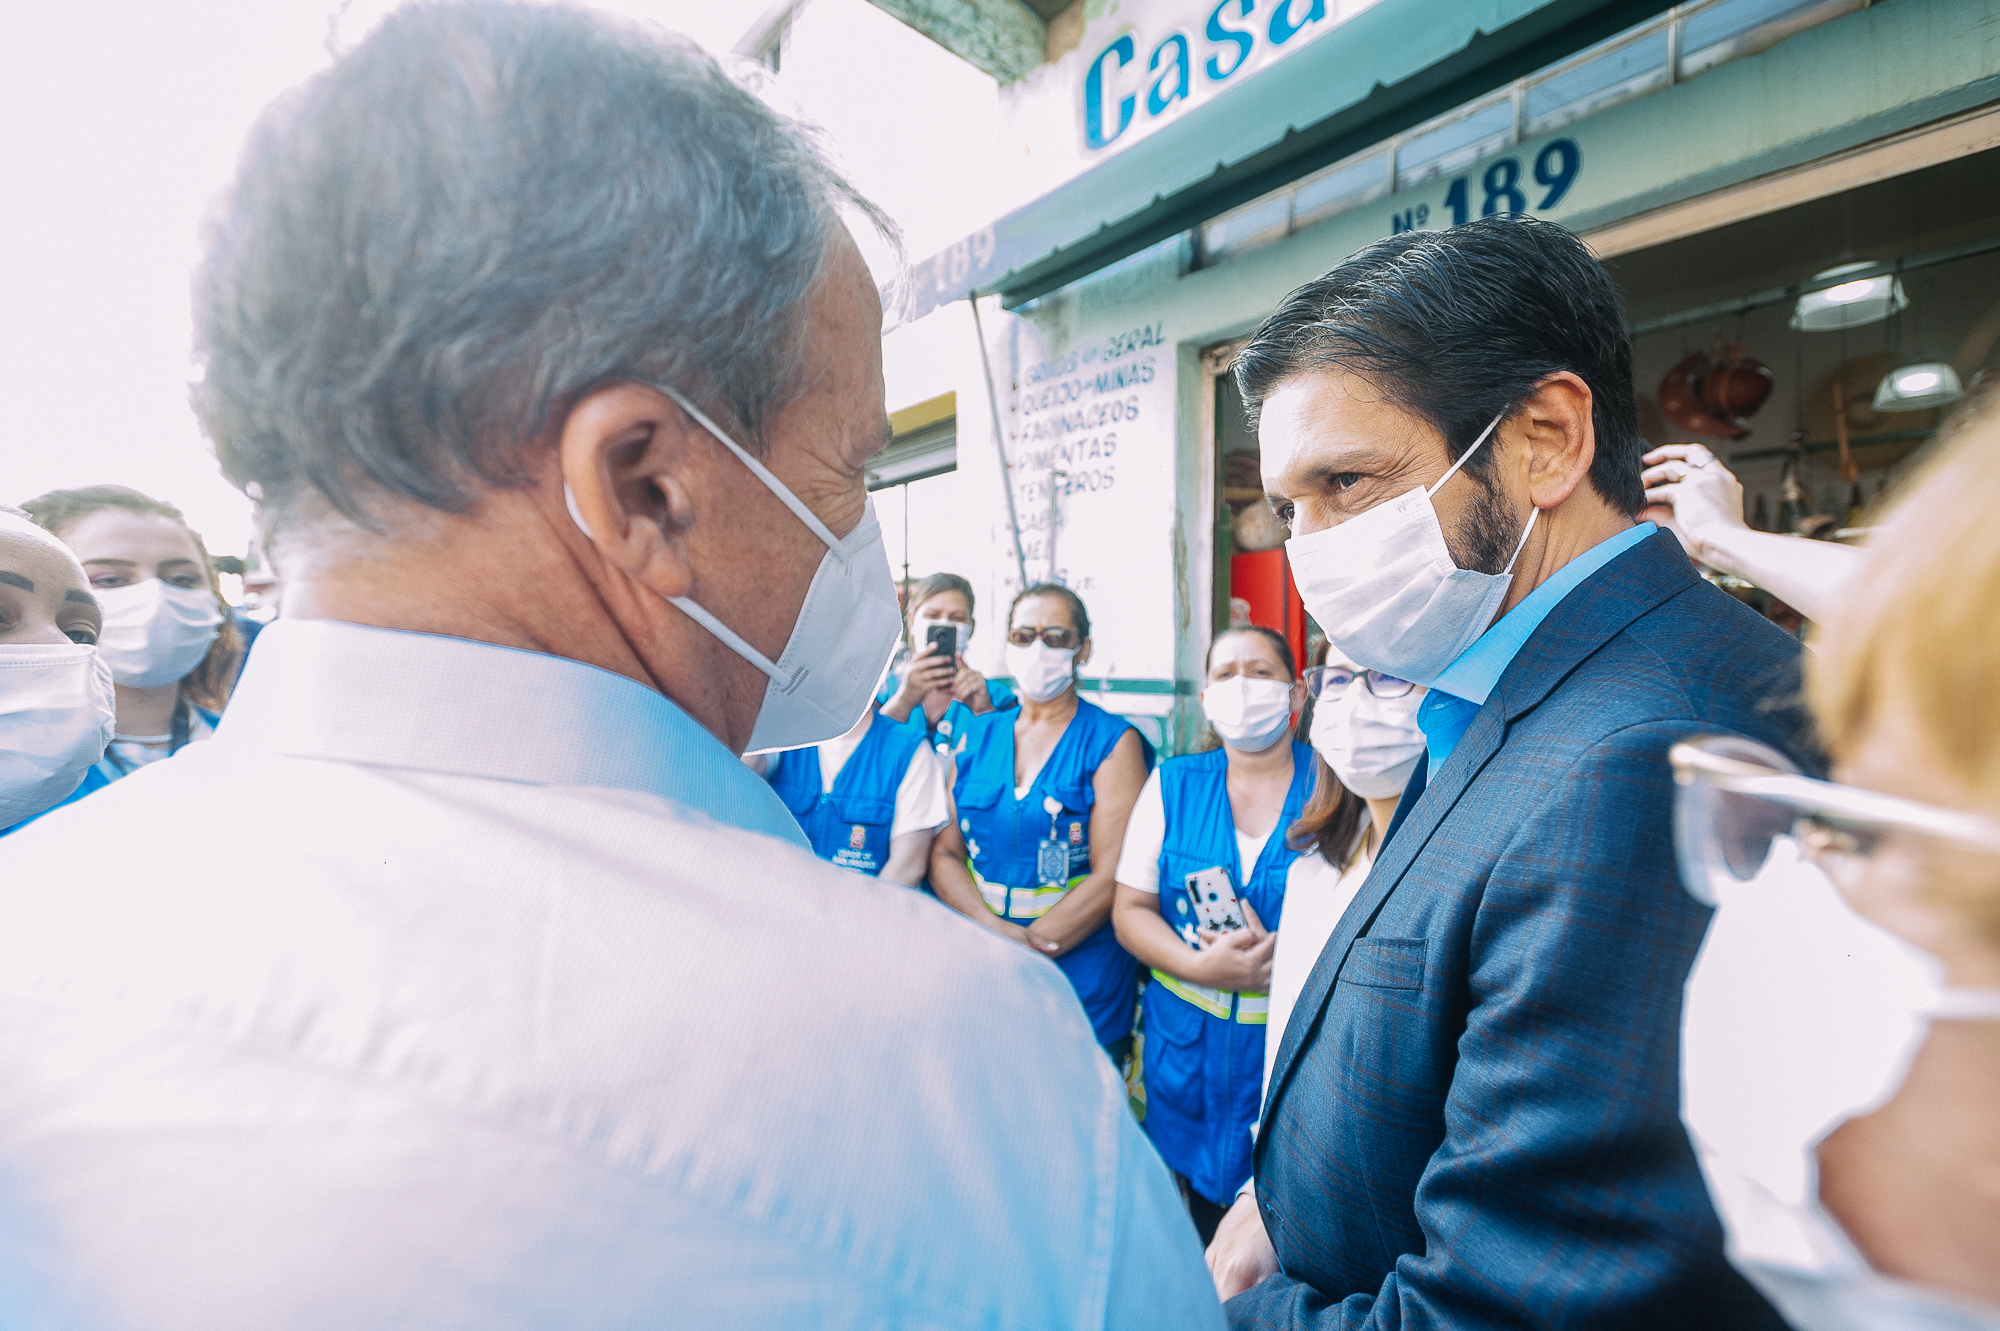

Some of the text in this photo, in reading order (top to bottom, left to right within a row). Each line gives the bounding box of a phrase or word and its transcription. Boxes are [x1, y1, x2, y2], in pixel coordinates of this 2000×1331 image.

[1444, 137, 1580, 227] 189
[932, 223, 996, 293] 189
[1102, 320, 1166, 362] GERAL
[1094, 356, 1155, 395] MINAS
[1018, 432, 1117, 473] PIMENTAS
[1018, 465, 1115, 501] TEMEROS
